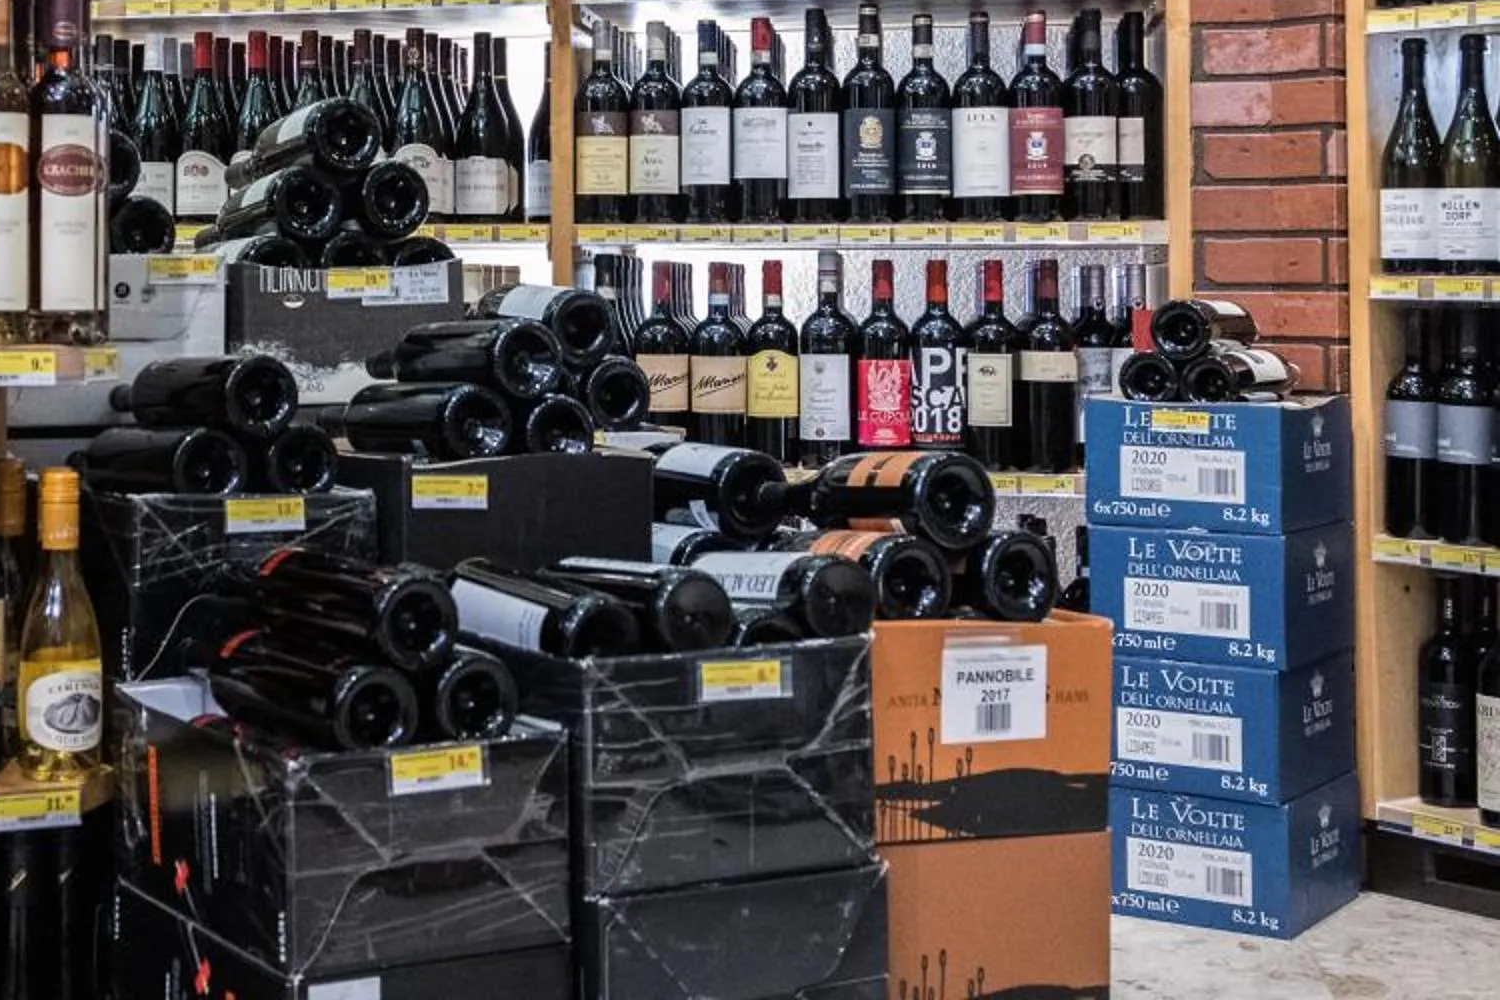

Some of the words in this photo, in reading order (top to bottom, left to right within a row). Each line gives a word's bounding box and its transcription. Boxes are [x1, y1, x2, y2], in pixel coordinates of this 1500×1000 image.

[1123, 405, 1151, 427] LE
[1157, 433, 1235, 448] ORNELLAIA
[1131, 450, 1167, 465] 2020
[1093, 501, 1137, 516] 6x750
[1222, 507, 1248, 521] 8.2
[1251, 508, 1270, 526] kg
[1128, 537, 1156, 559] LE
[1167, 540, 1242, 564] VOLTE
[1163, 563, 1241, 582] ORNELLAIA
[1133, 582, 1169, 598] 2020
[1228, 641, 1253, 657] 8.2
[1257, 643, 1276, 662] kg
[956, 667, 1035, 684] PANNOBILE
[1121, 665, 1149, 689] LE
[1161, 669, 1235, 697] VOLTE
[980, 687, 1011, 702] 2017
[1155, 695, 1233, 715] ORNELLAIA
[1125, 711, 1161, 728] 2020
[1220, 775, 1245, 791] 8.2
[1249, 776, 1268, 797] kg
[1132, 797, 1159, 820] LE
[1170, 801, 1245, 832] VOLTE
[1166, 826, 1244, 848] ORNELLAIA
[1137, 843, 1174, 862] 2020
[1231, 908, 1256, 924] 8.2
[1261, 910, 1279, 930] kg
